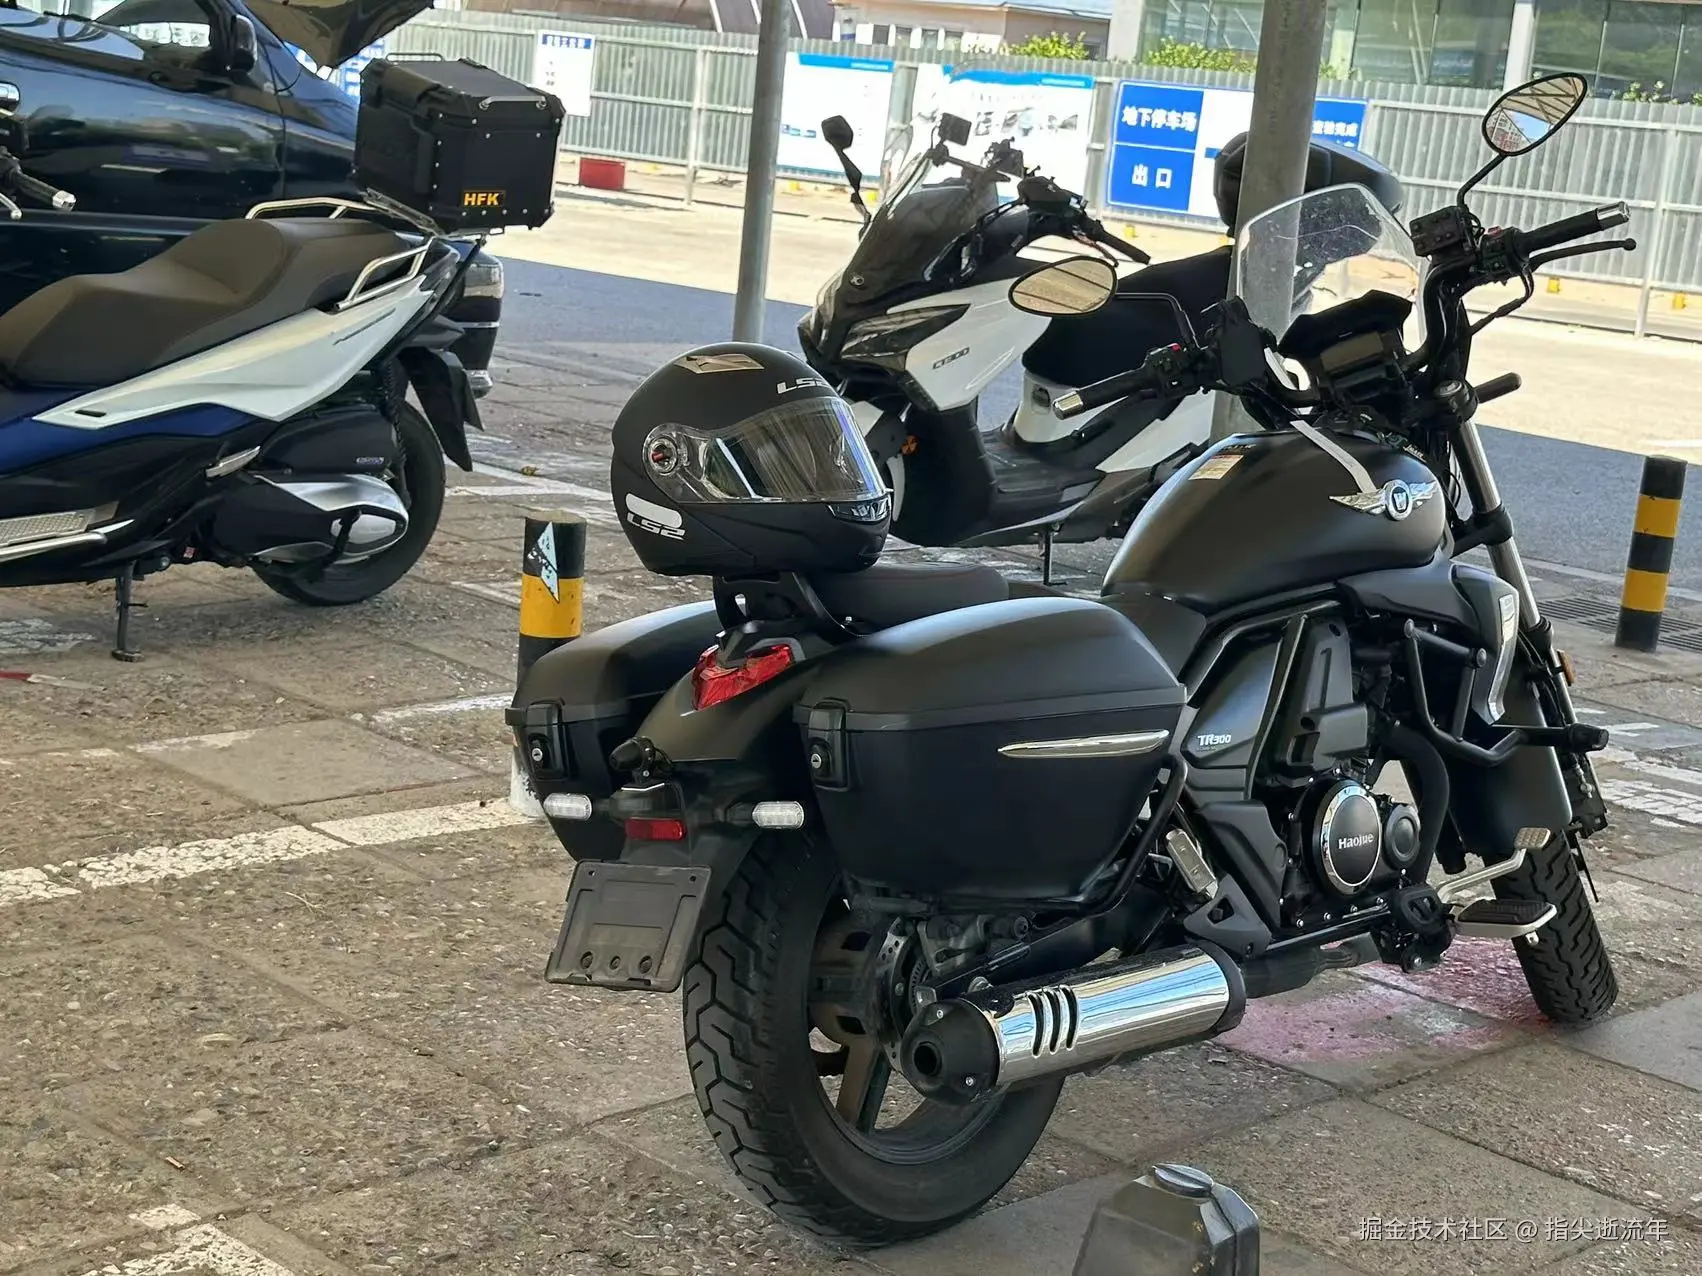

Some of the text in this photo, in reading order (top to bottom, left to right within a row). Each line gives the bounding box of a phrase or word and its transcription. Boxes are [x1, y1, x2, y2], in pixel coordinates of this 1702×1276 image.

[1122, 105, 1197, 132] 地下停车场
[1132, 164, 1172, 188] 出口
[464, 193, 499, 206] HFK
[626, 512, 686, 541] LS2
[1197, 733, 1232, 747] TR300
[1338, 833, 1374, 850] Haojue
